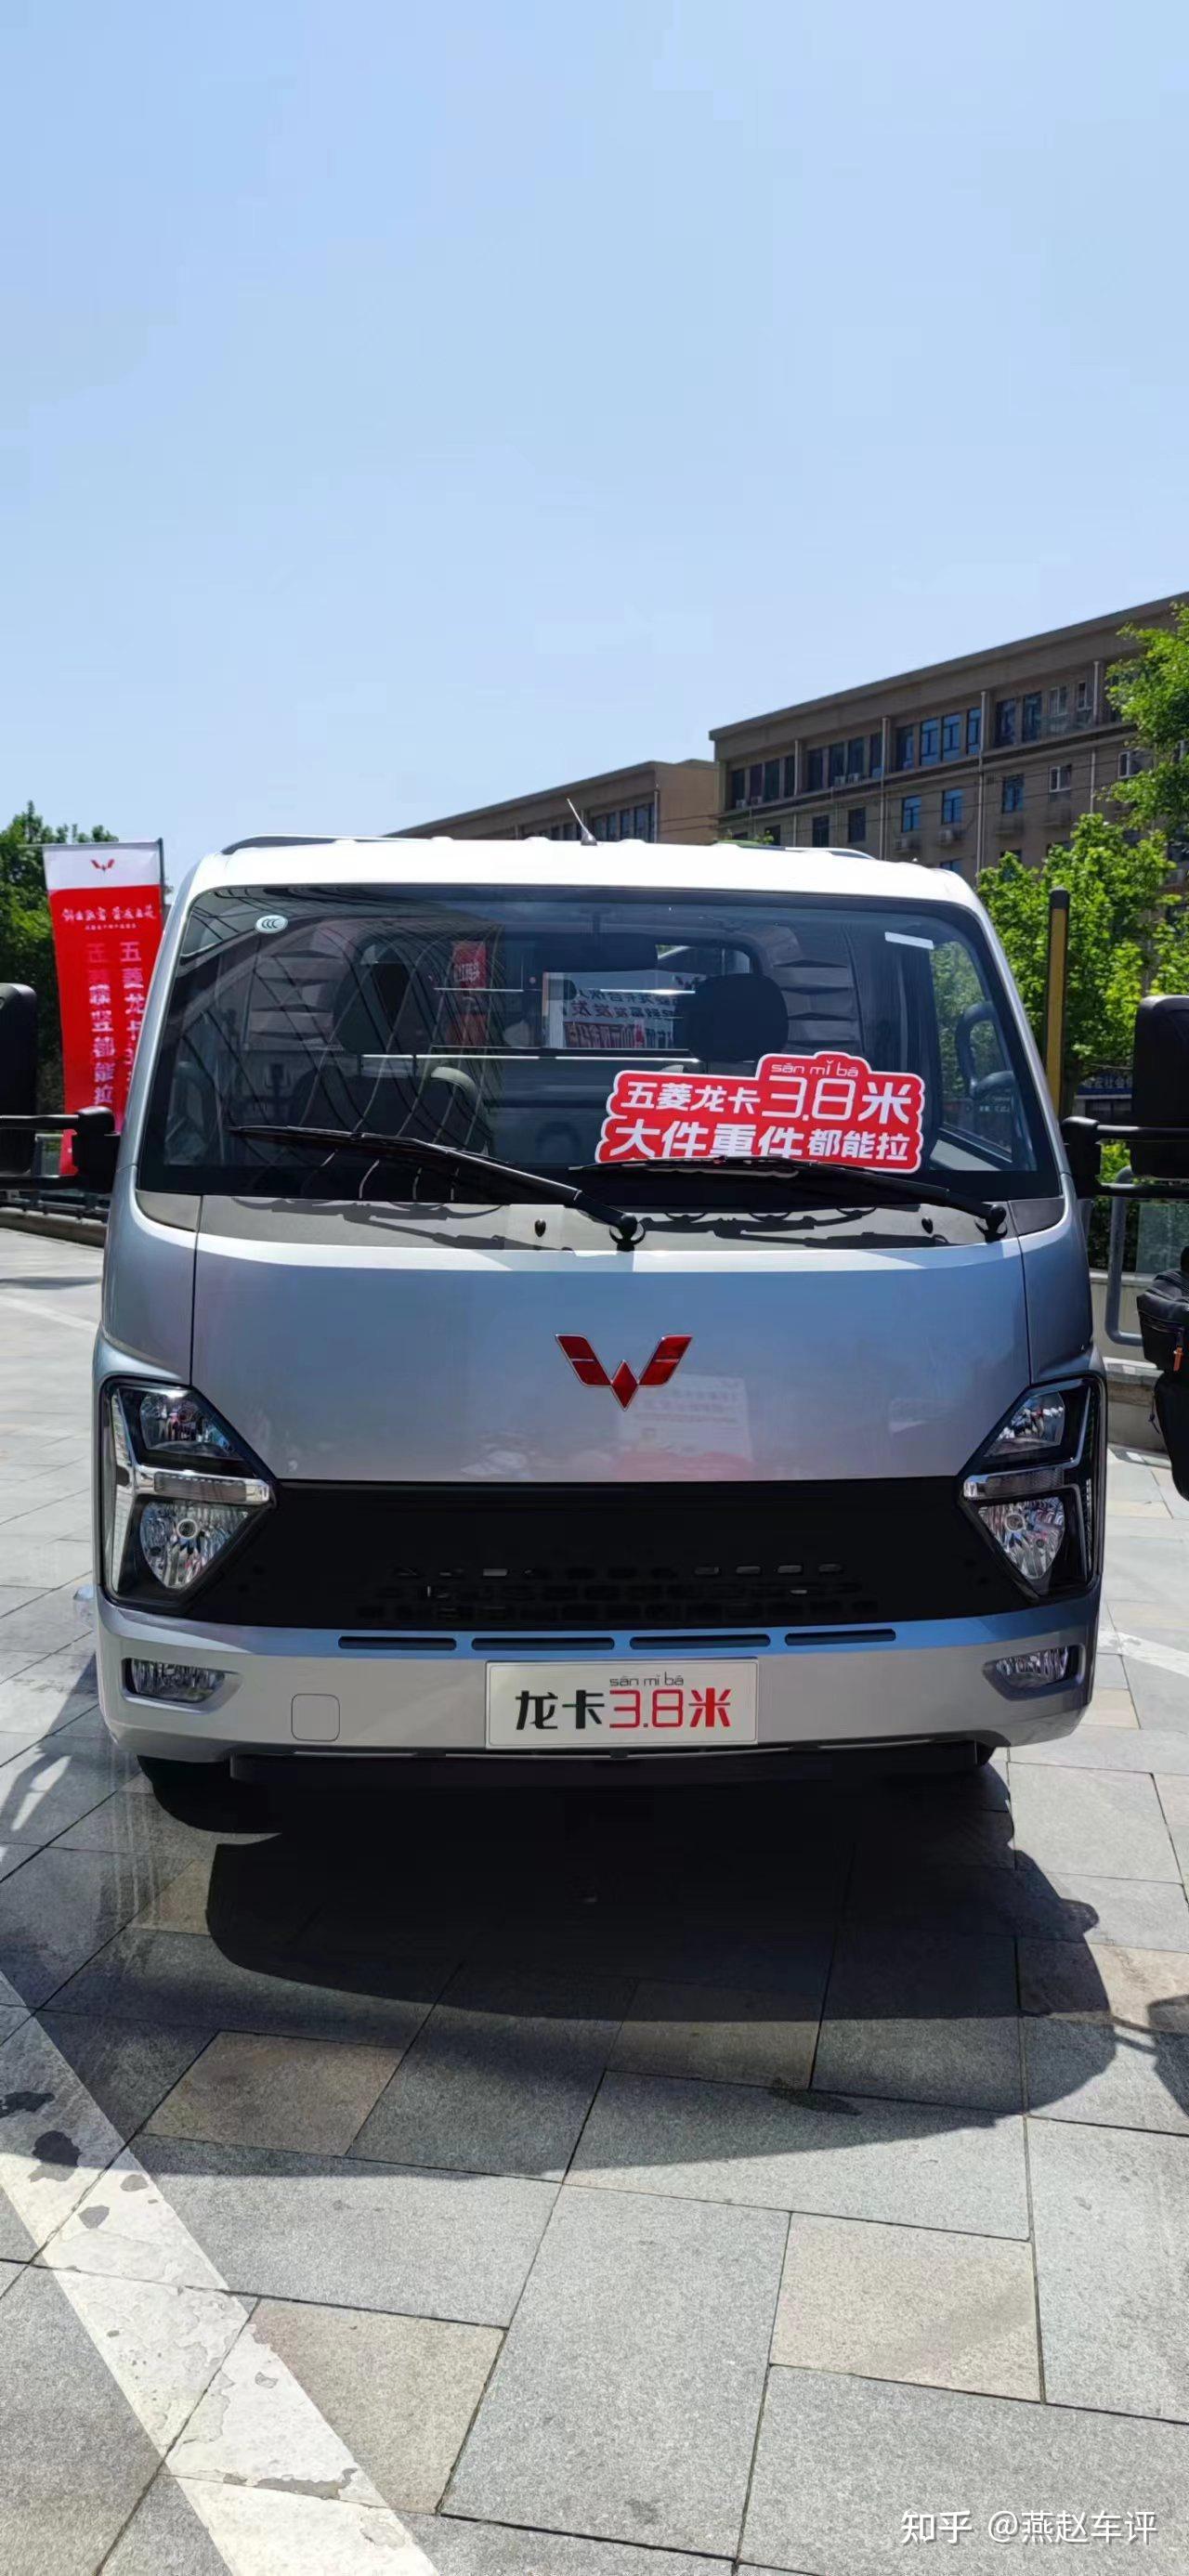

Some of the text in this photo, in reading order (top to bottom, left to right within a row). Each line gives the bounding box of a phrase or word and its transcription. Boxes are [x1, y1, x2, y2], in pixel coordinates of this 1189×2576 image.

[620, 1074, 912, 1125] 五菱龙卡3.8米
[608, 1118, 911, 1162] 大件重件都能拉
[515, 1687, 732, 1731] 龙卡3.8米
